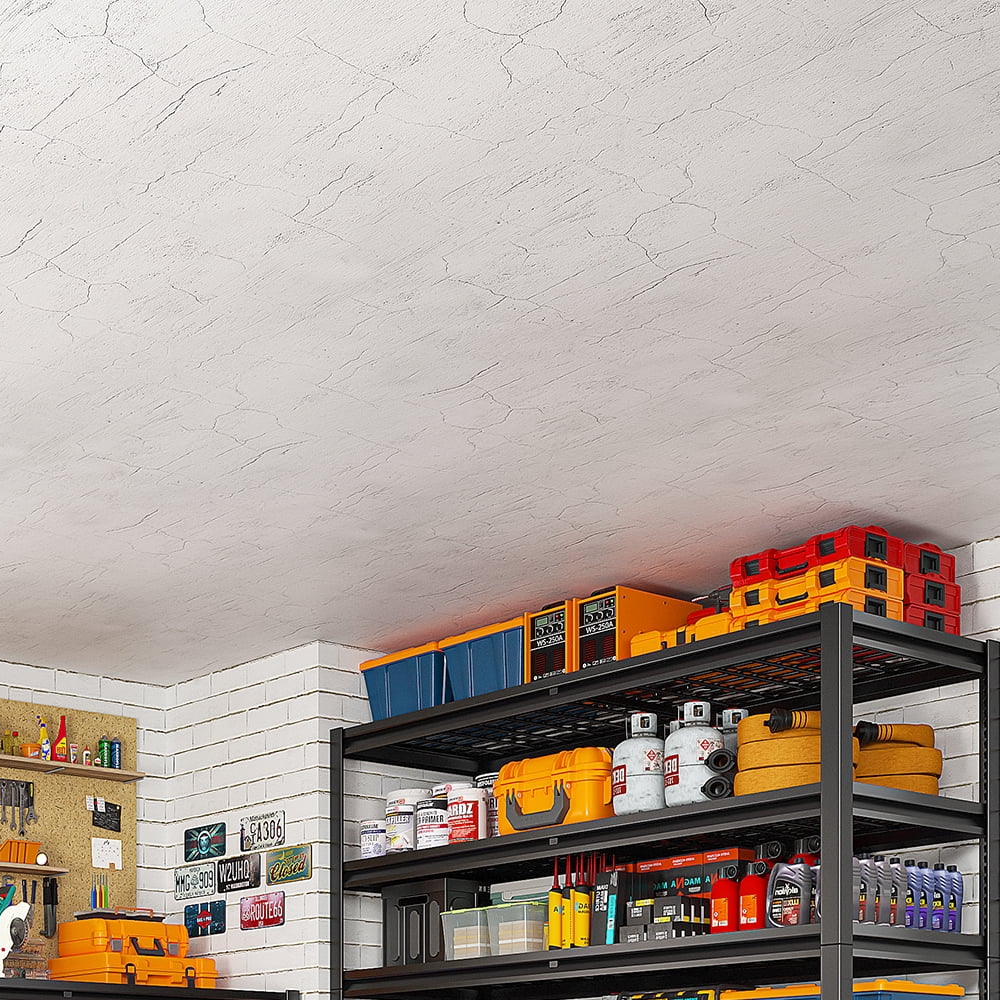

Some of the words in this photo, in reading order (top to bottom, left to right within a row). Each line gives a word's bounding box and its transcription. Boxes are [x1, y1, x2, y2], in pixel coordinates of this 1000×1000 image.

[585, 621, 614, 633] WS-250A
[536, 635, 563, 647] WS-250A
[218, 859, 250, 883] W2UHQ
[269, 854, 307, 881] Closed
[199, 870, 214, 889] 909
